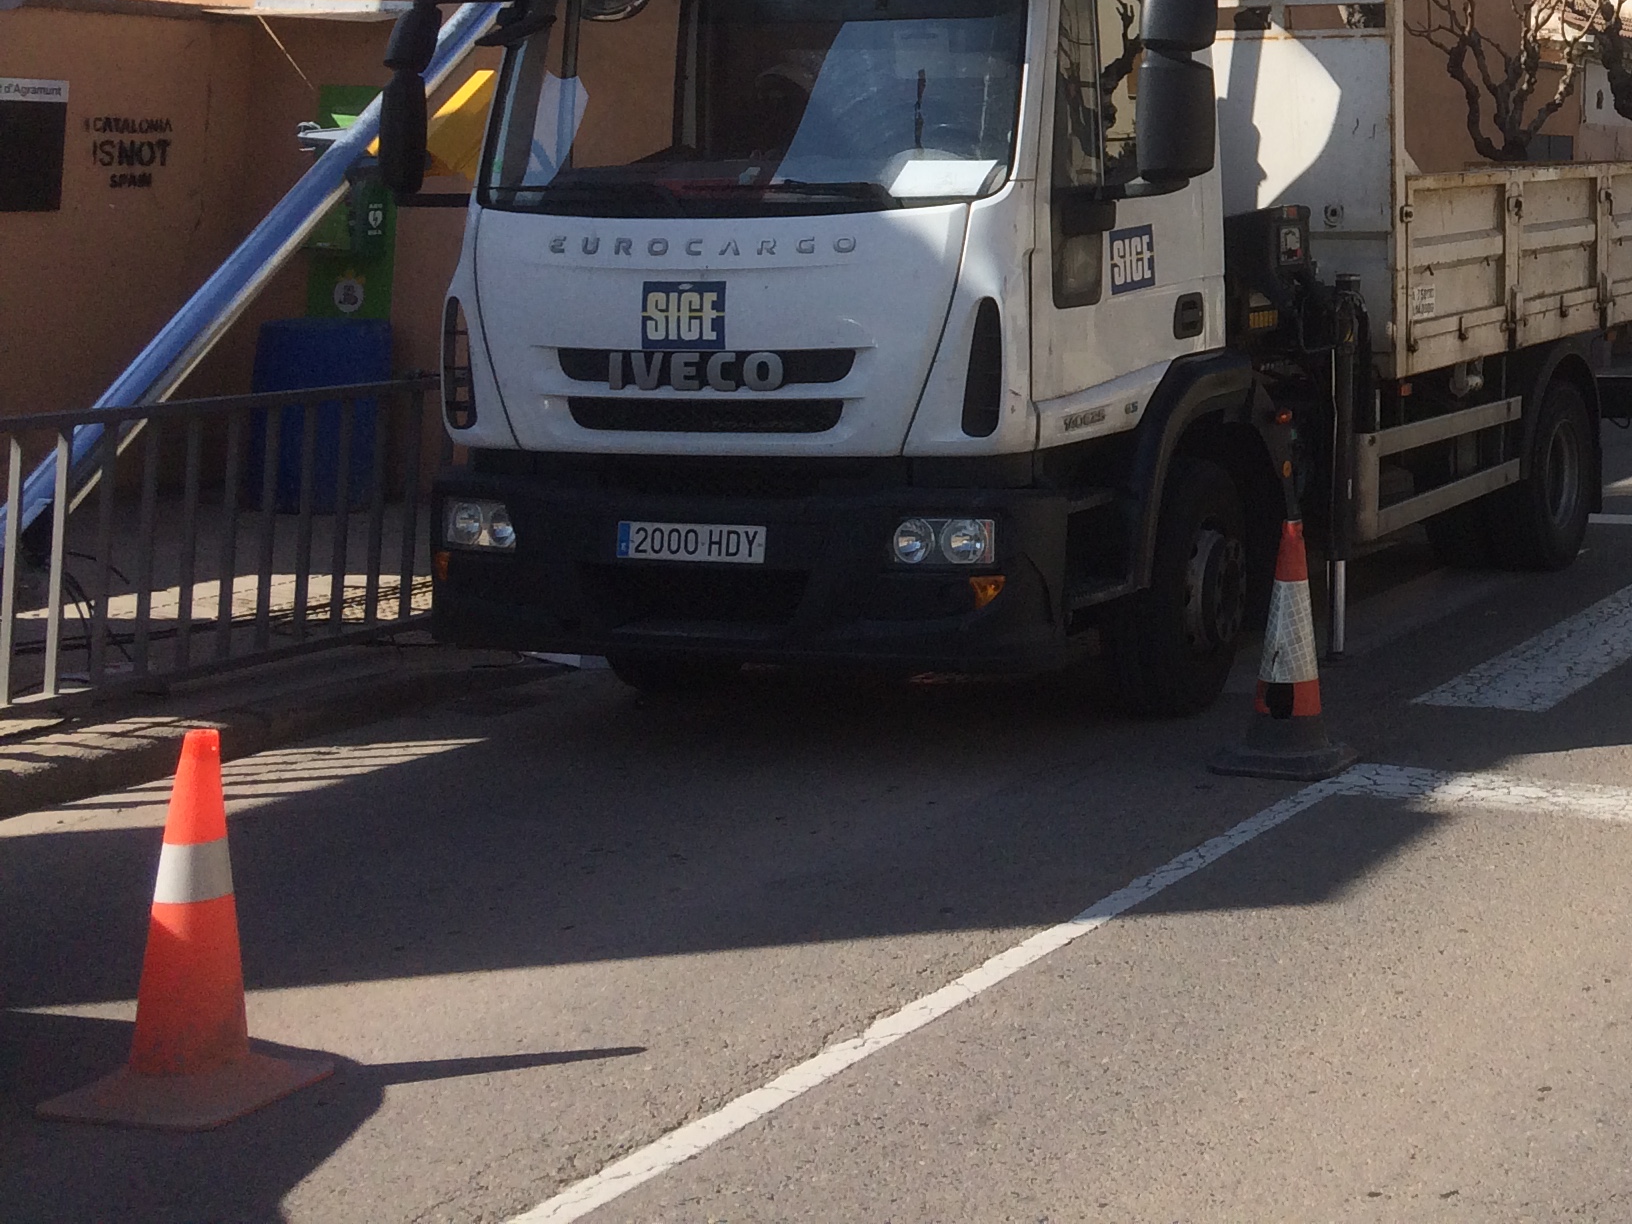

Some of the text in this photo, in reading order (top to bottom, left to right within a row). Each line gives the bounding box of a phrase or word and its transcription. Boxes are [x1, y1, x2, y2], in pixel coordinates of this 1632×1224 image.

[4, 83, 62, 97] d'Agramunt
[548, 235, 857, 256] EUROCARGO
[1113, 234, 1152, 286] SICE
[646, 292, 718, 340] SICE
[608, 351, 784, 392] IVECO
[634, 527, 699, 555] 2000
[707, 529, 758, 558] HDY
